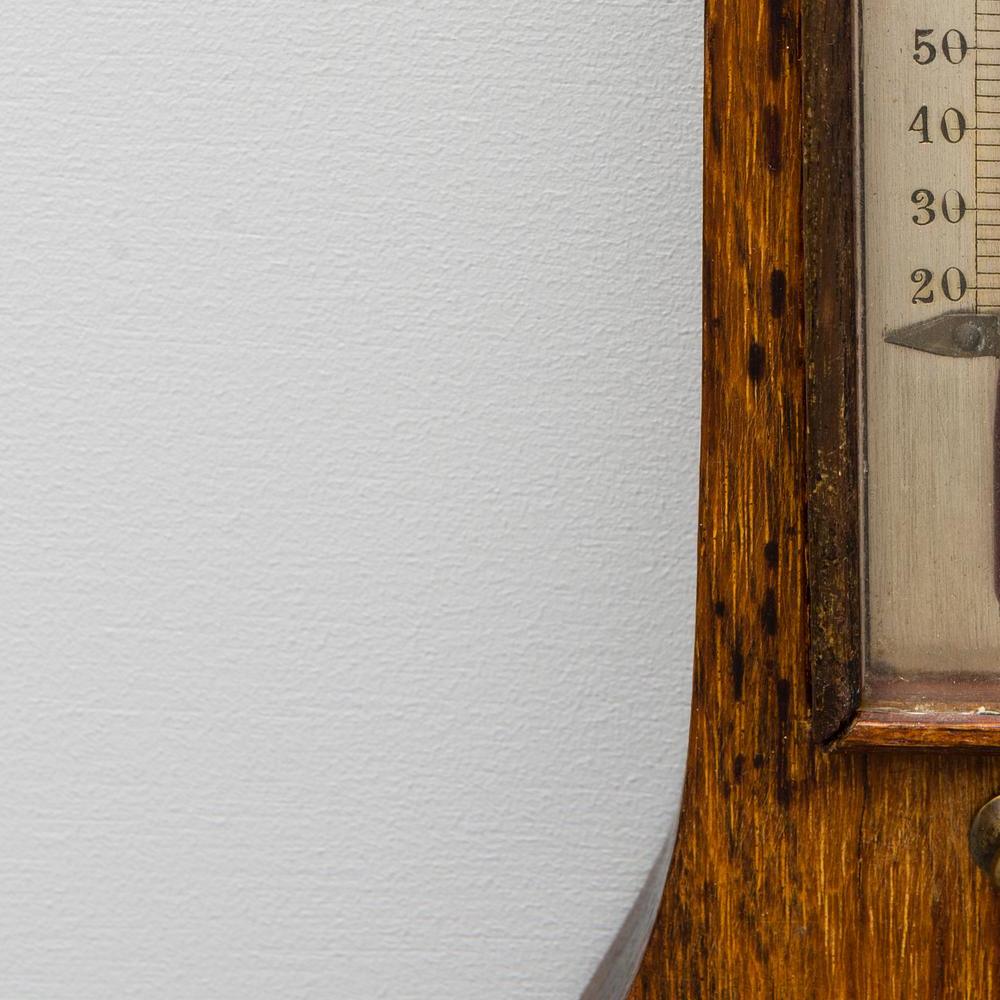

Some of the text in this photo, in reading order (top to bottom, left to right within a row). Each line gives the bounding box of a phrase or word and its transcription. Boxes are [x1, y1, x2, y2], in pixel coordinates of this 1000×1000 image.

[911, 28, 969, 66] 50
[908, 105, 967, 145] 40
[910, 187, 968, 226] 30
[911, 265, 968, 305] 20
